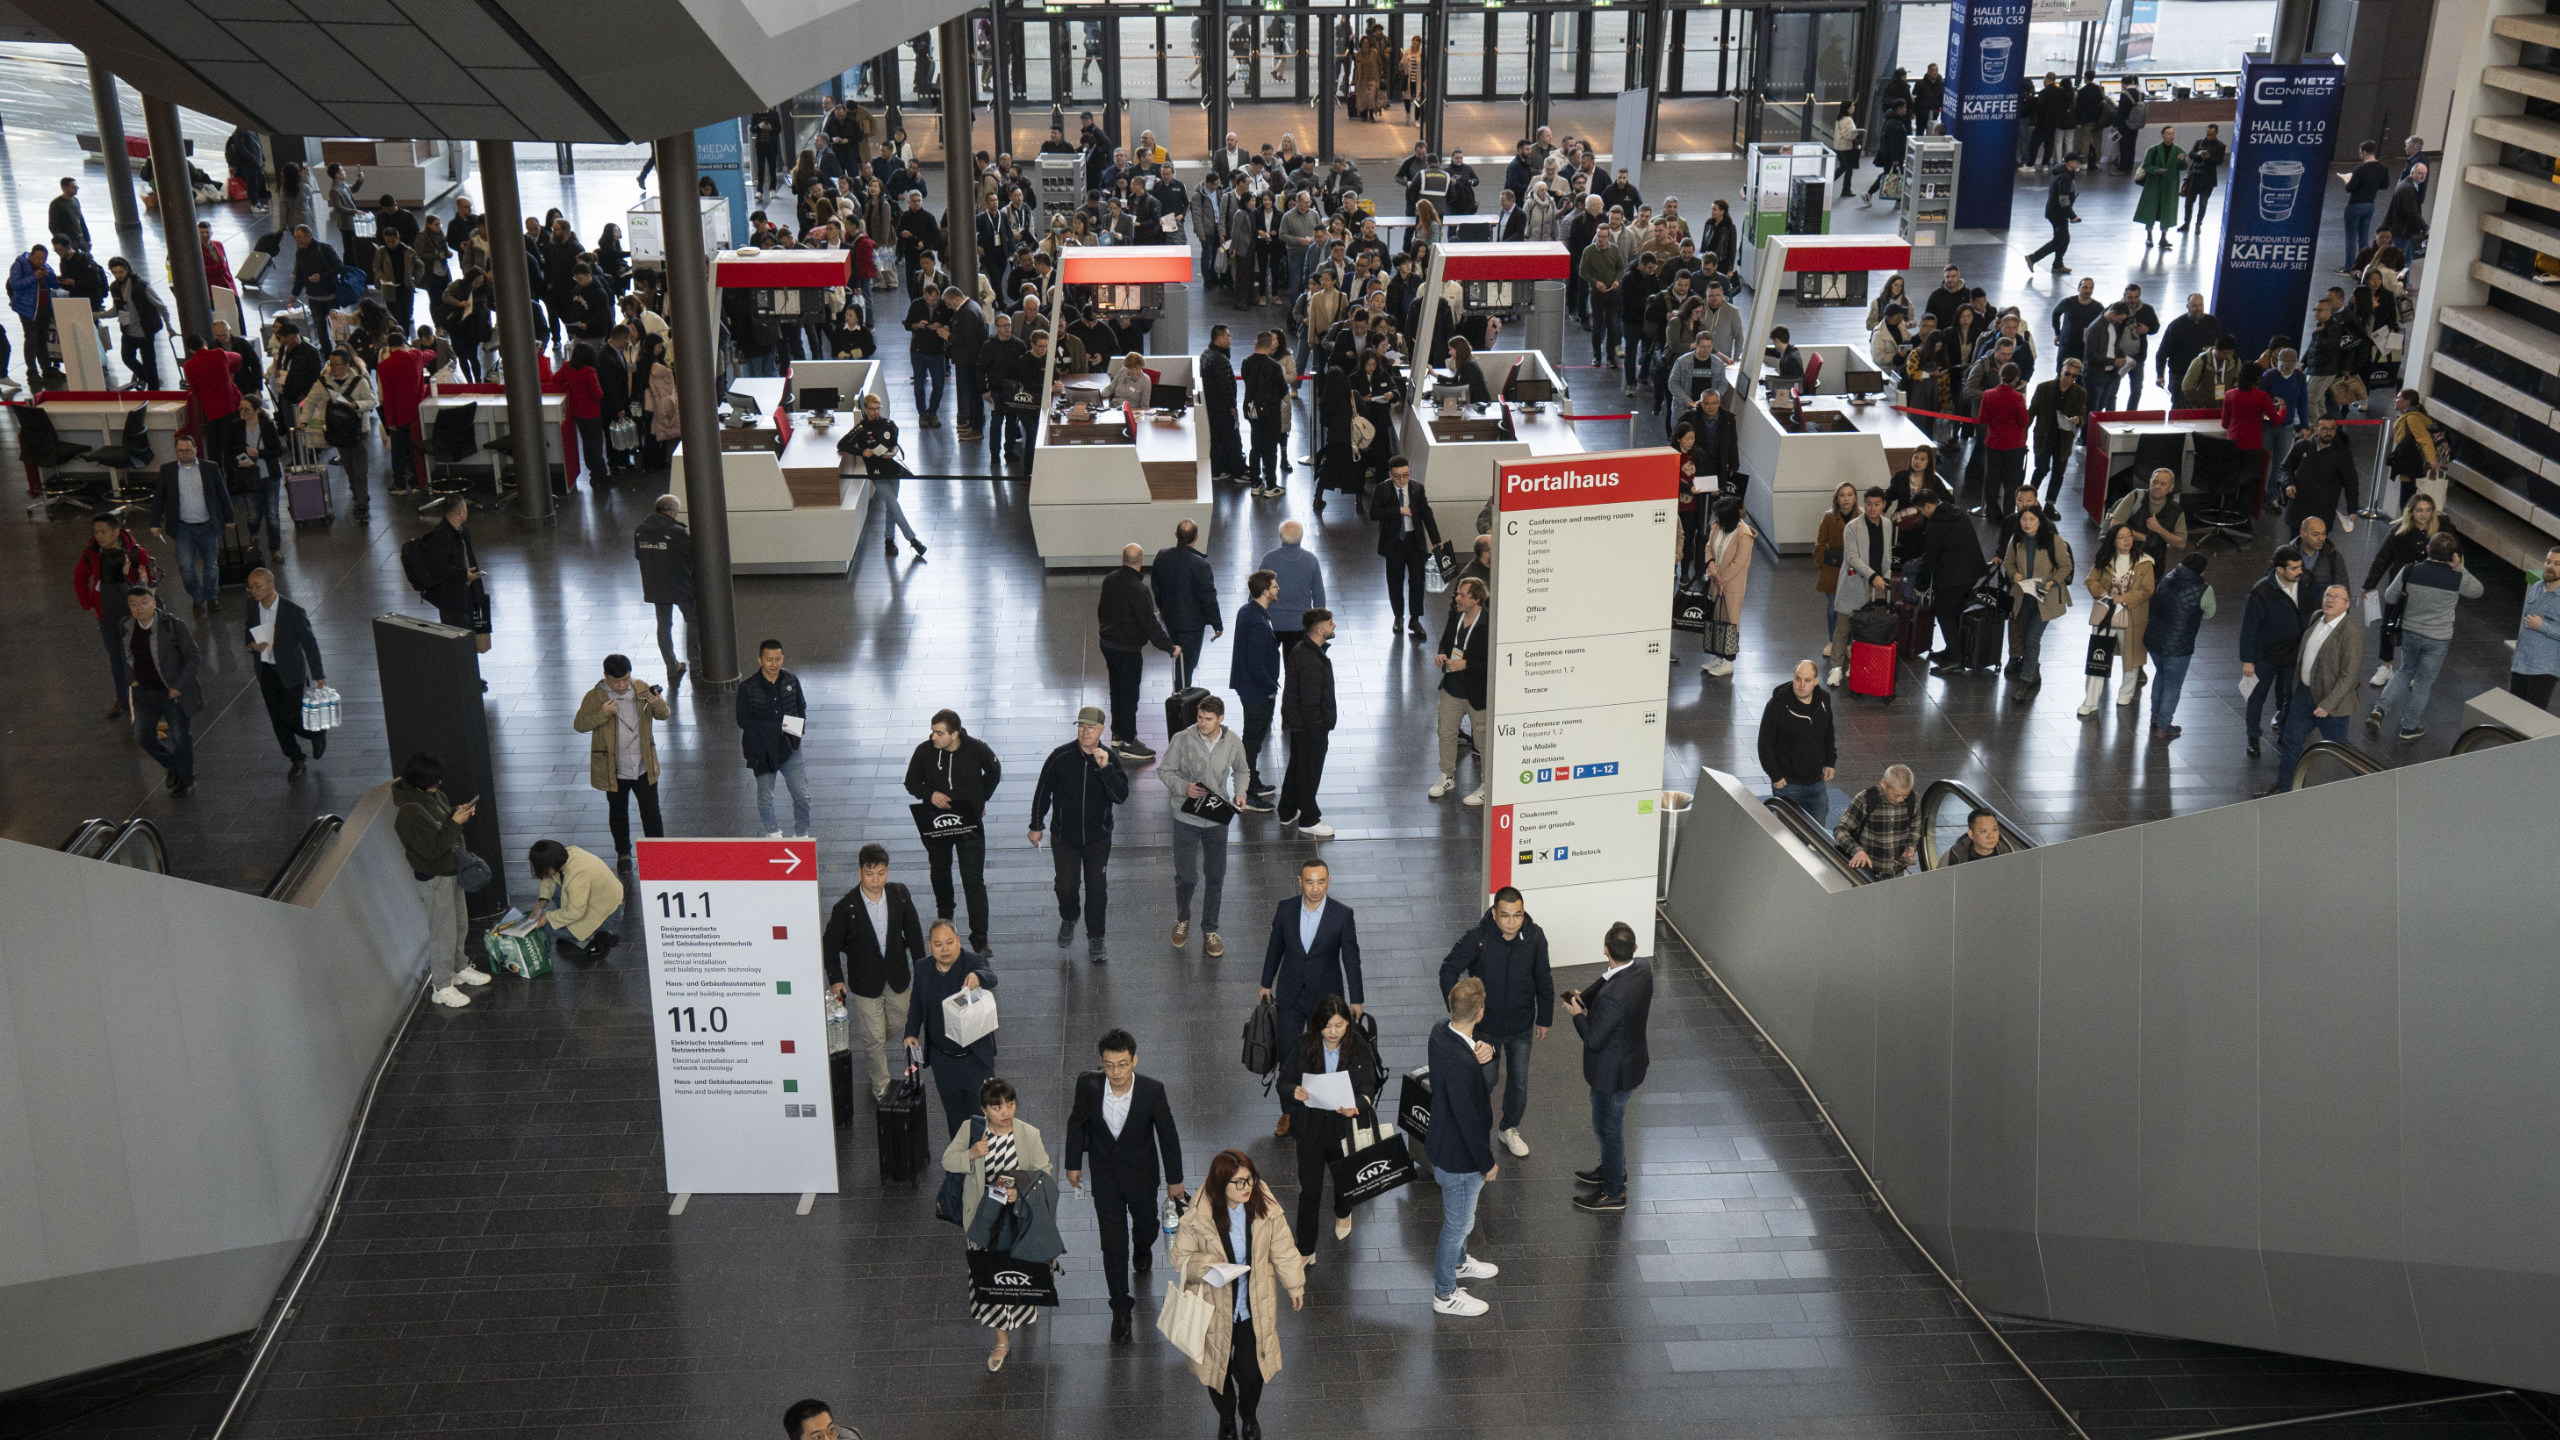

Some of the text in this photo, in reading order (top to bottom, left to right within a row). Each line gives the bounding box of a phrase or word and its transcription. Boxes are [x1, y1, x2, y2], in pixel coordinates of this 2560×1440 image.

[1974, 7, 2002, 16] HALLE
[2006, 6, 2025, 14] 11.0
[1973, 17, 2003, 25] STAND
[2006, 16, 2024, 24] C55
[1963, 100, 2017, 113] KAFFEE
[2252, 121, 2326, 132] HALLE 11.0
[2250, 134, 2323, 144] STAND C55
[698, 144, 737, 152] NIEDAX
[2231, 244, 2309, 260] KAFFEE
[2230, 261, 2268, 269] WARTEN
[2290, 262, 2307, 270] SIE!
[1507, 471, 1620, 493] Portalhaus
[1529, 518, 1567, 526] Conference
[1584, 514, 1611, 522] meeting
[1508, 521, 1518, 535] C
[1528, 567, 1554, 575] Objektiv
[1683, 609, 1704, 619] KNX
[1525, 649, 1563, 658] Conference
[1506, 653, 1512, 666] 1
[1525, 660, 1552, 668] Sequenz
[1524, 668, 1562, 677] Transparenz
[1523, 720, 1560, 729] Conference
[1498, 725, 1516, 737] Via
[1523, 730, 1550, 738] Frequenz
[1532, 755, 1564, 764] directions
[1523, 773, 1530, 782] S
[1540, 771, 1548, 780] U
[1577, 768, 1584, 776] P
[1520, 810, 1558, 819] Cloakrooms
[933, 816, 963, 828] KNX
[1500, 814, 1510, 829] 0
[1549, 821, 1575, 830] grounds
[1558, 850, 1565, 858] P
[1572, 849, 1601, 857] Rebstock
[657, 892, 711, 918] 11.1
[668, 1006, 728, 1032] 11.0
[1356, 1162, 1391, 1184] KNX
[994, 1273, 1032, 1285] KNX
